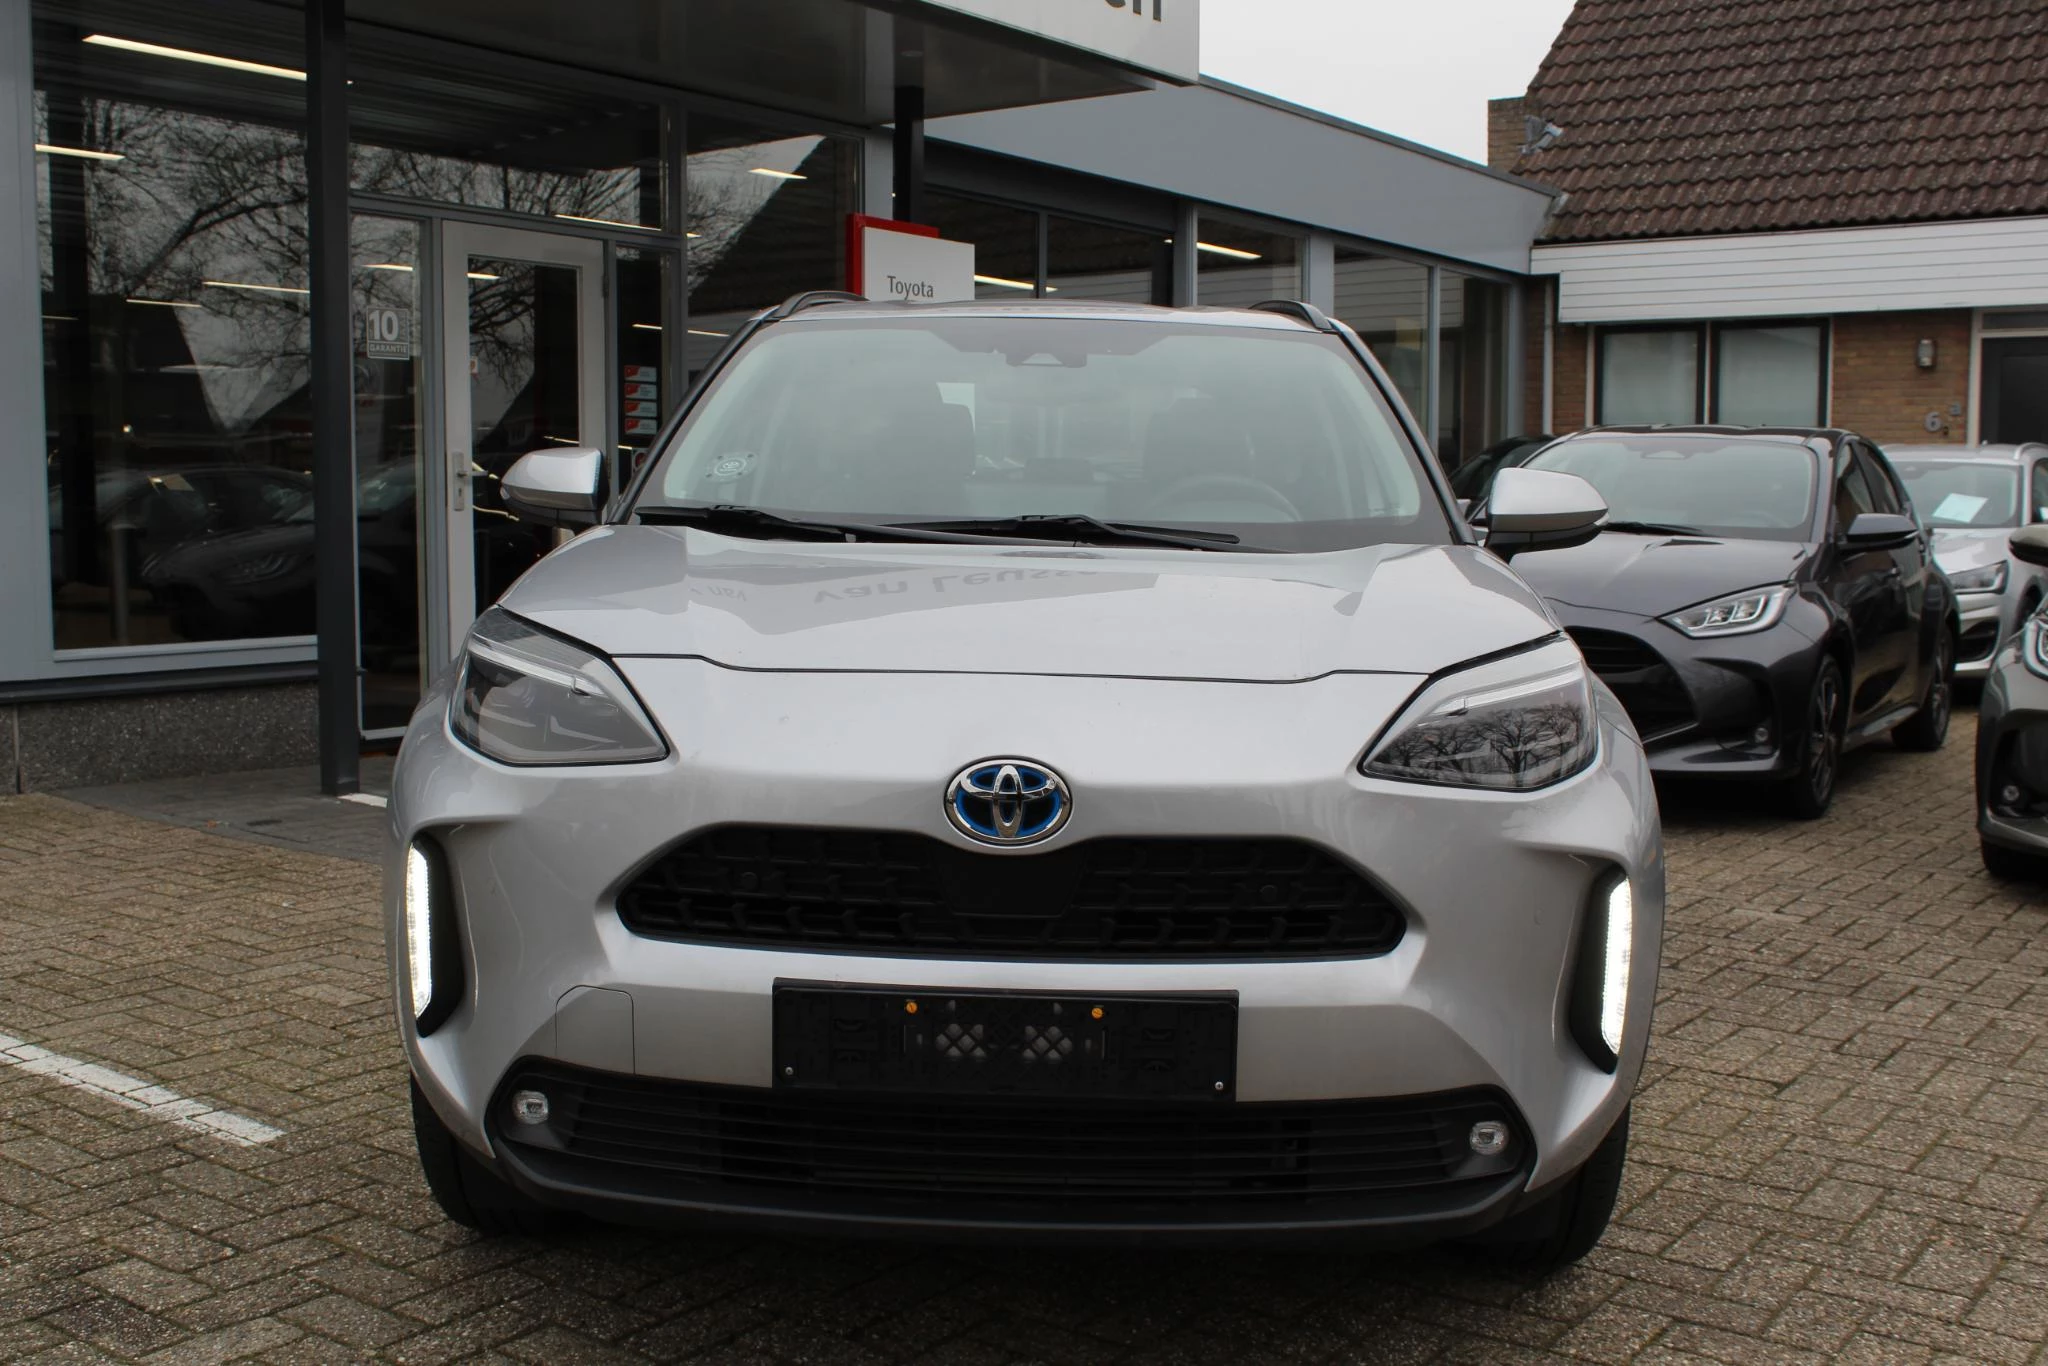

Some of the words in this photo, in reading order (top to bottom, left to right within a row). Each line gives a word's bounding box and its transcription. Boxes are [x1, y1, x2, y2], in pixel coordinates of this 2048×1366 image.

[887, 275, 934, 300] Toyota
[368, 309, 399, 341] 10
[368, 343, 408, 353] GARANTIE
